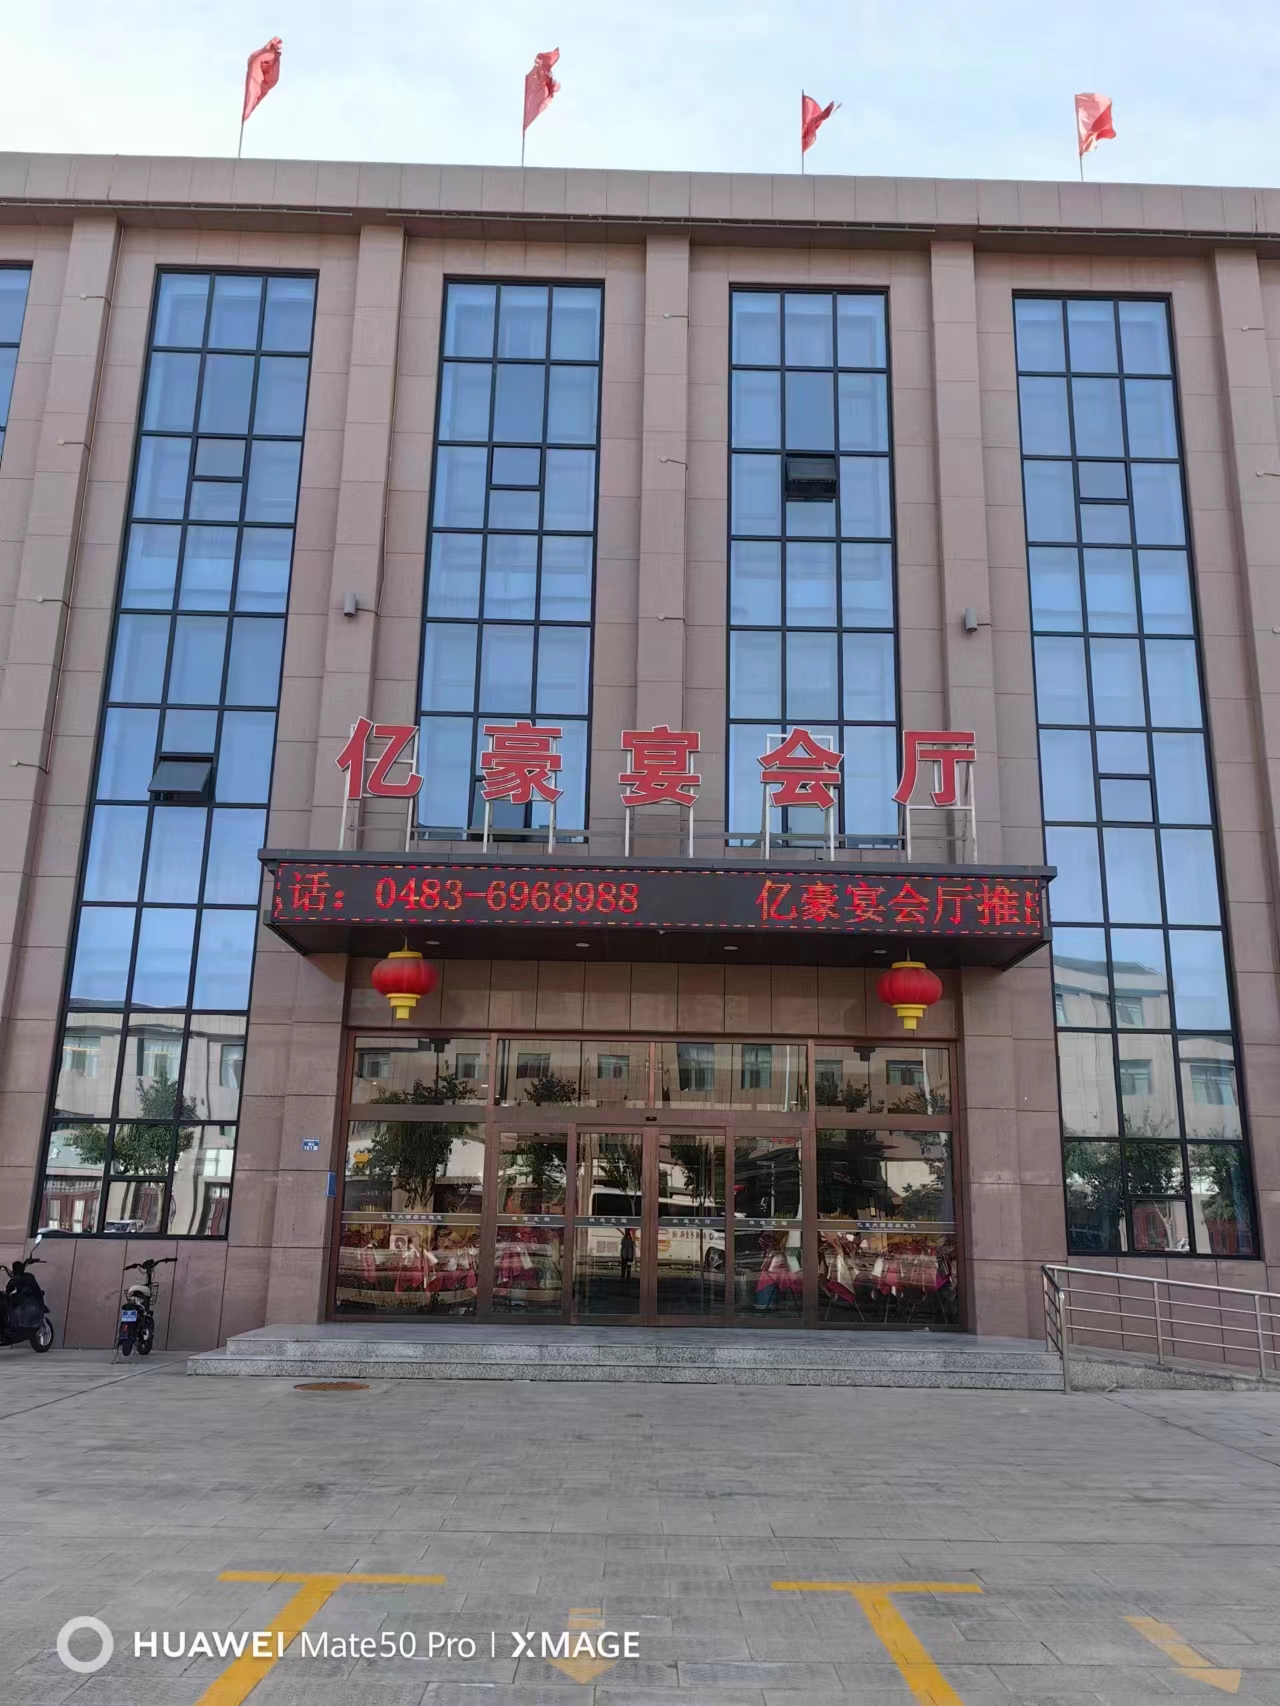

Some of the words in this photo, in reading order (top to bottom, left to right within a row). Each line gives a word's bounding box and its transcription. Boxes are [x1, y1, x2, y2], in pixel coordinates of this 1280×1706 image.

[335, 716, 977, 810] 亿豪宴会厅
[375, 877, 640, 913] 0483-6968988
